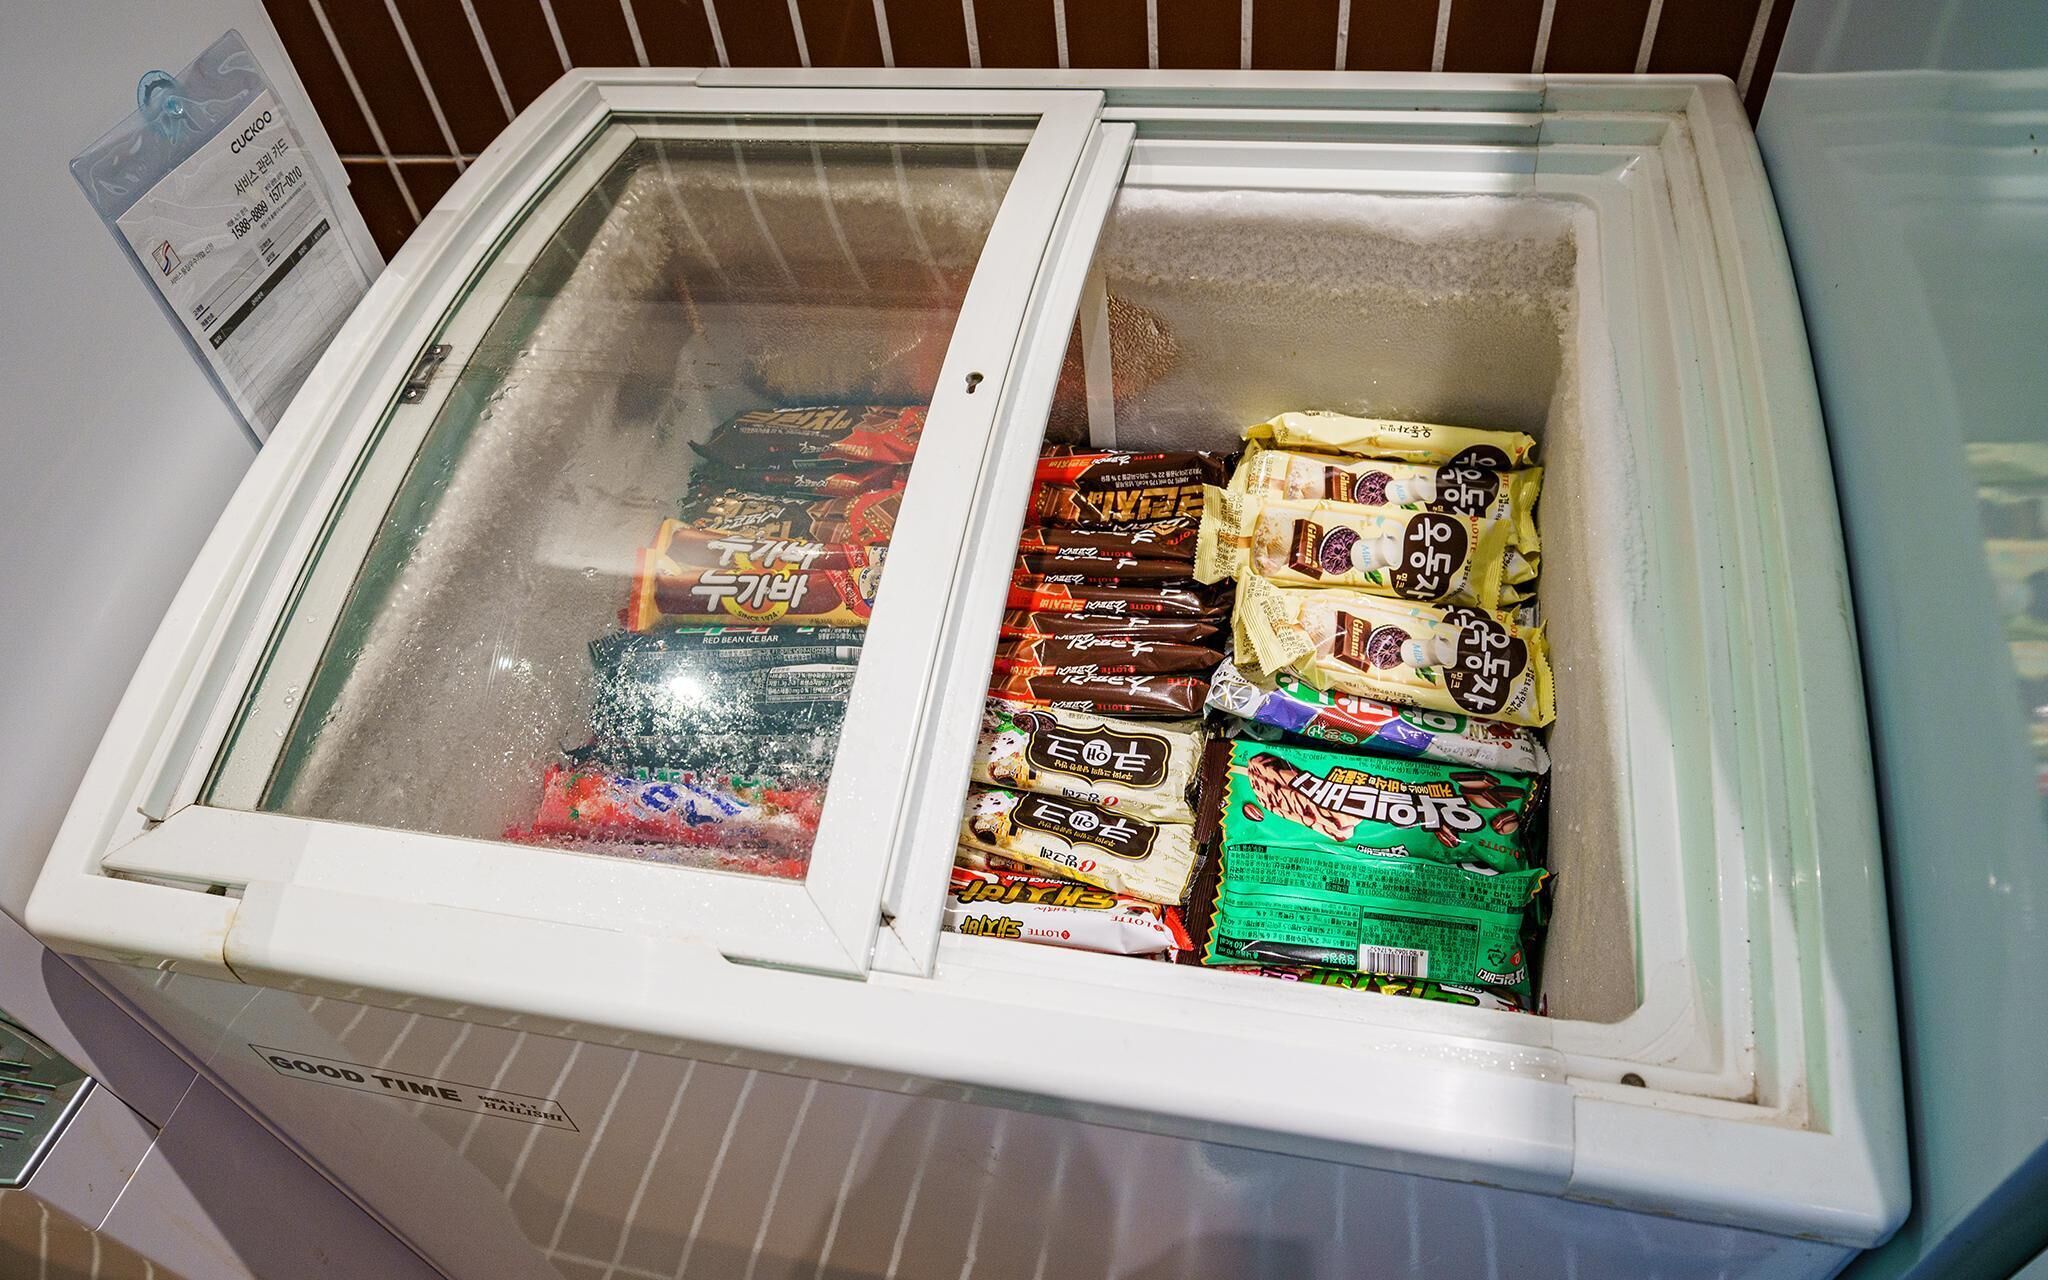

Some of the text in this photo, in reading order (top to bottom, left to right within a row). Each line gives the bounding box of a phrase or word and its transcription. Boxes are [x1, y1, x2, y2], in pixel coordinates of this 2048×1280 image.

[231, 111, 272, 154] CUCKOO
[234, 138, 288, 196] 서비스 관리 카드
[268, 166, 302, 204] 1577-0010
[232, 200, 268, 240] 1588-8899
[1398, 425, 1432, 438] 옥동자
[1341, 472, 1350, 502] Ghana
[1304, 524, 1318, 564] Ghana
[1470, 524, 1480, 552] LOTTE
[1362, 544, 1370, 567] Milk
[1406, 518, 1452, 599] 옥동자
[690, 570, 809, 612] 누가바
[1396, 573, 1408, 588] 밀크
[737, 610, 760, 622] SINCE
[1086, 600, 1127, 614] 초코퍼지
[1130, 603, 1156, 611] LOTTE
[702, 634, 779, 644] RED BEAN ICE BAR
[1351, 618, 1364, 658] Ghana
[1413, 644, 1424, 663] Milk
[1056, 664, 1099, 676] 초코퍼지
[1102, 666, 1130, 674] LOTTE
[1451, 672, 1464, 688] 밀크
[1464, 630, 1510, 710] 옥동자
[1047, 734, 1150, 772] 쿠앤크
[1054, 759, 1133, 780] 쿠키와 크림의 달콤한 만남
[1062, 788, 1100, 803] 빙그레
[1408, 785, 1429, 794] 아이스
[1429, 784, 1454, 798] 커피
[1291, 772, 1484, 830] 와일드바디
[1033, 799, 1137, 843] 쿠앤크
[1038, 820, 1116, 848] 쿠키와 크림의 달콤한 만남
[1040, 846, 1078, 868] 빙그레
[1357, 844, 1409, 858] 와일드바디
[1479, 838, 1515, 856] LOTTE
[957, 879, 1118, 910] 돼지바
[960, 914, 1060, 938] LOTTE 돼지바
[1111, 914, 1153, 928] LOTTE
[1219, 937, 1234, 949] kcal
[1321, 952, 1356, 966] 영양정보
[268, 1055, 364, 1083] GOOD
[371, 1075, 462, 1102] TIME
[484, 1101, 564, 1122] HAILISHI
